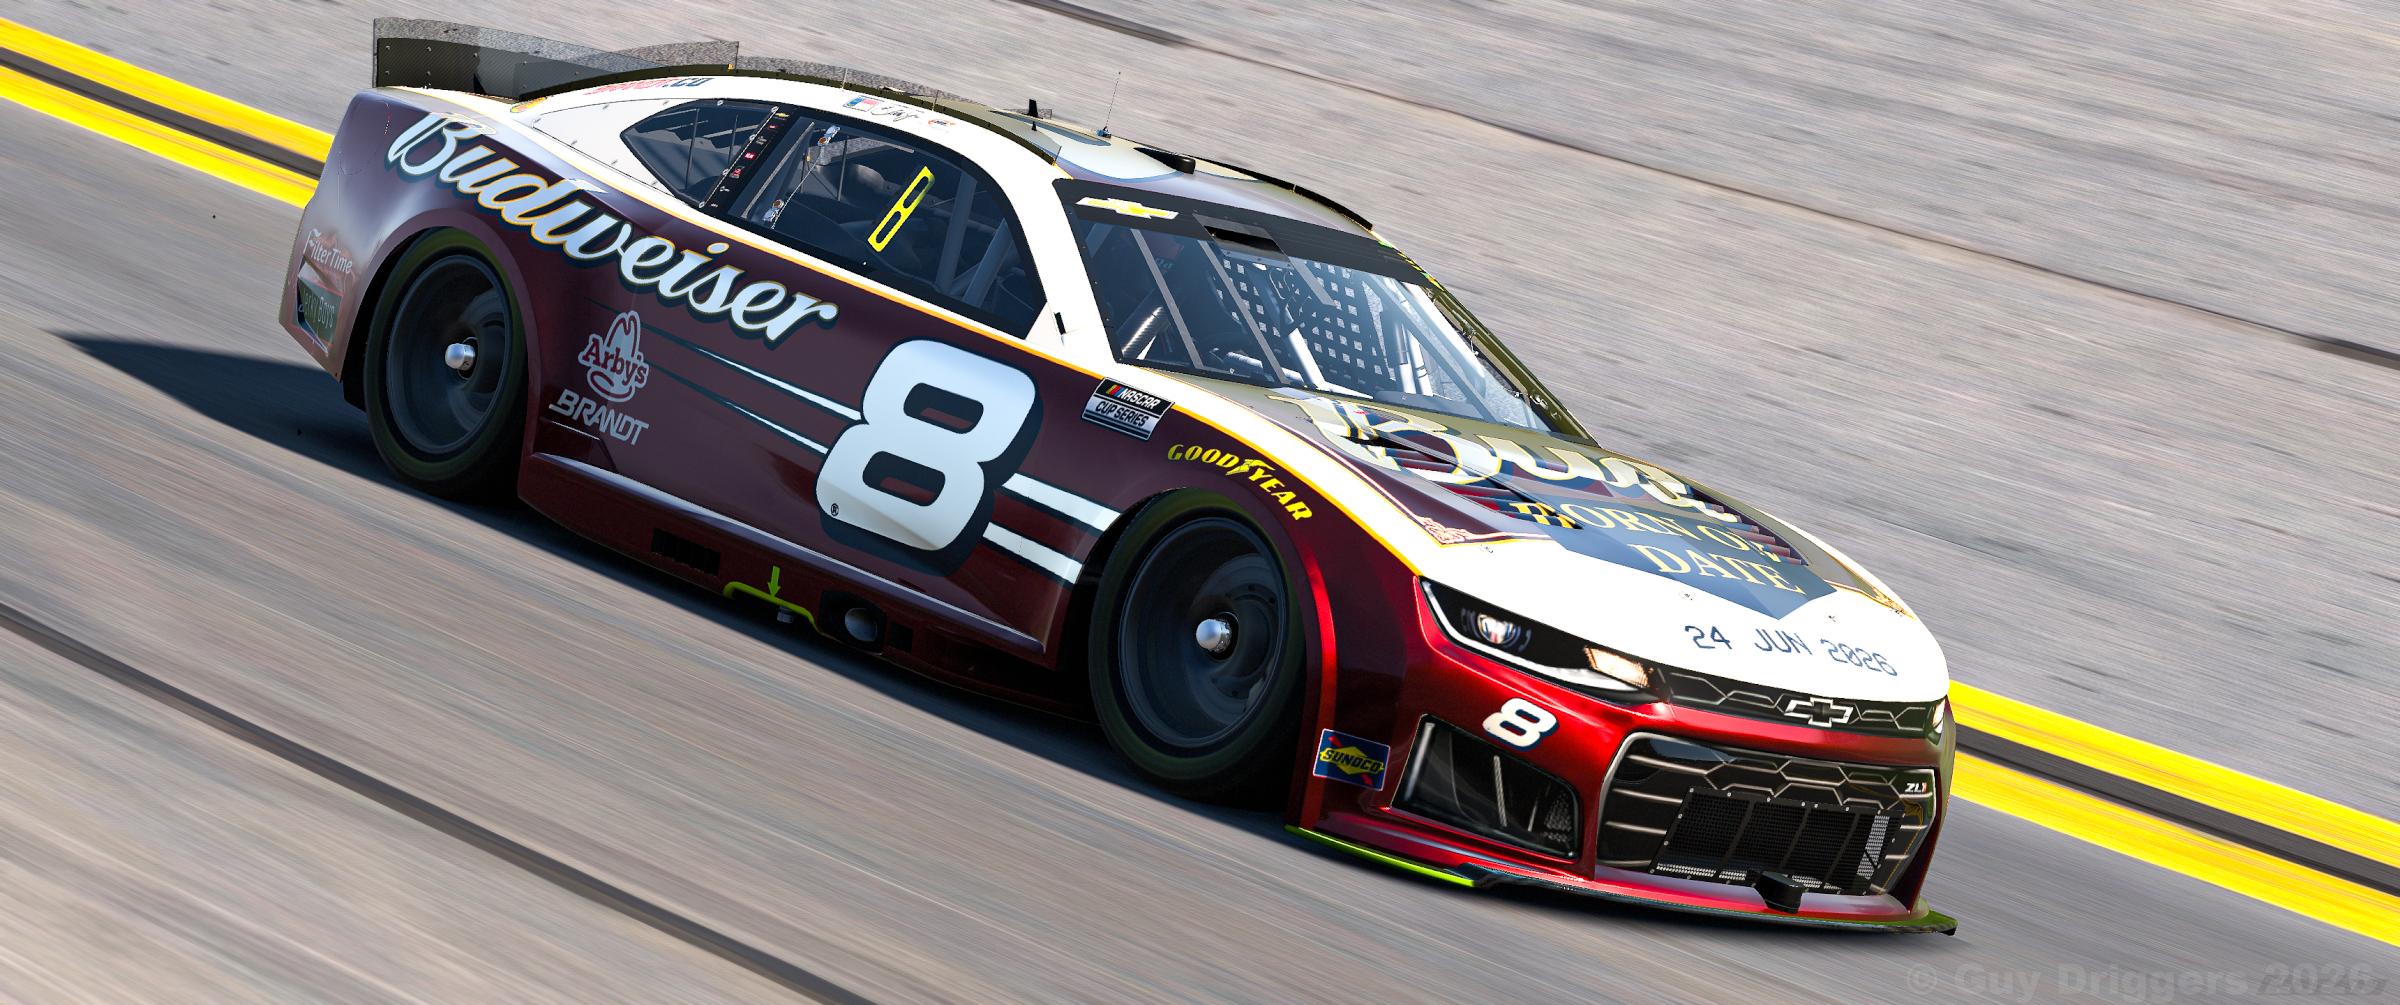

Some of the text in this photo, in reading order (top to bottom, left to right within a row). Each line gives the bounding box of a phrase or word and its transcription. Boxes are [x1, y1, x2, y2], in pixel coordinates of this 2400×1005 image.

[386, 112, 840, 344] Budweiser
[867, 165, 936, 253] 8
[303, 228, 353, 274] FilterTime
[581, 337, 648, 387] Arby's
[548, 388, 650, 446] BRANDT
[1095, 400, 1149, 427] CUP SERIES
[1118, 387, 1161, 410] NASCAR
[814, 337, 1040, 560] 8
[1167, 443, 1313, 521] GOODYEAR
[1628, 543, 1808, 596] DATE
[1684, 625, 1898, 677] 24 JUN 2026
[1481, 696, 1560, 751] 8
[1321, 748, 1382, 774] SUNOCO
[1904, 782, 1928, 793] ZL1
